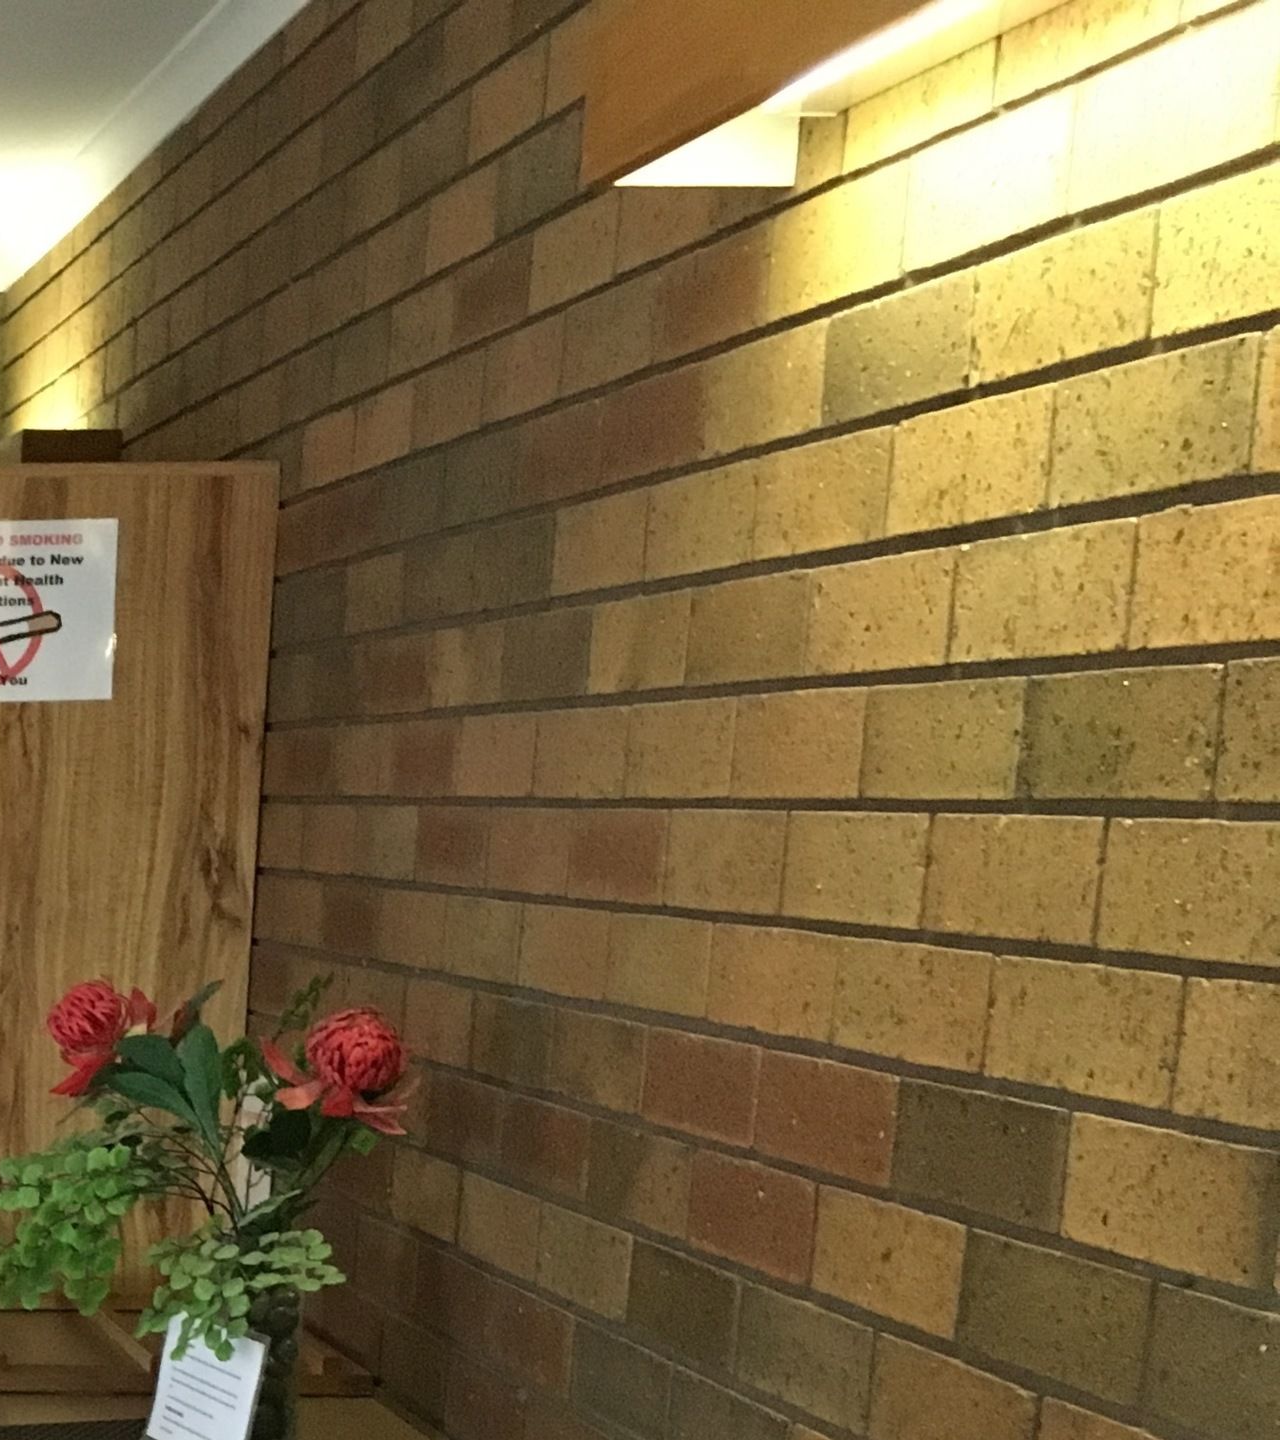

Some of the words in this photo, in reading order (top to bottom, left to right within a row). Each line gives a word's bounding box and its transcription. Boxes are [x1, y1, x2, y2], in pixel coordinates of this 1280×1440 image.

[10, 533, 83, 547] SMOKING
[30, 555, 45, 566] to
[50, 554, 84, 565] New
[14, 574, 64, 586] Health
[0, 675, 27, 686] You
